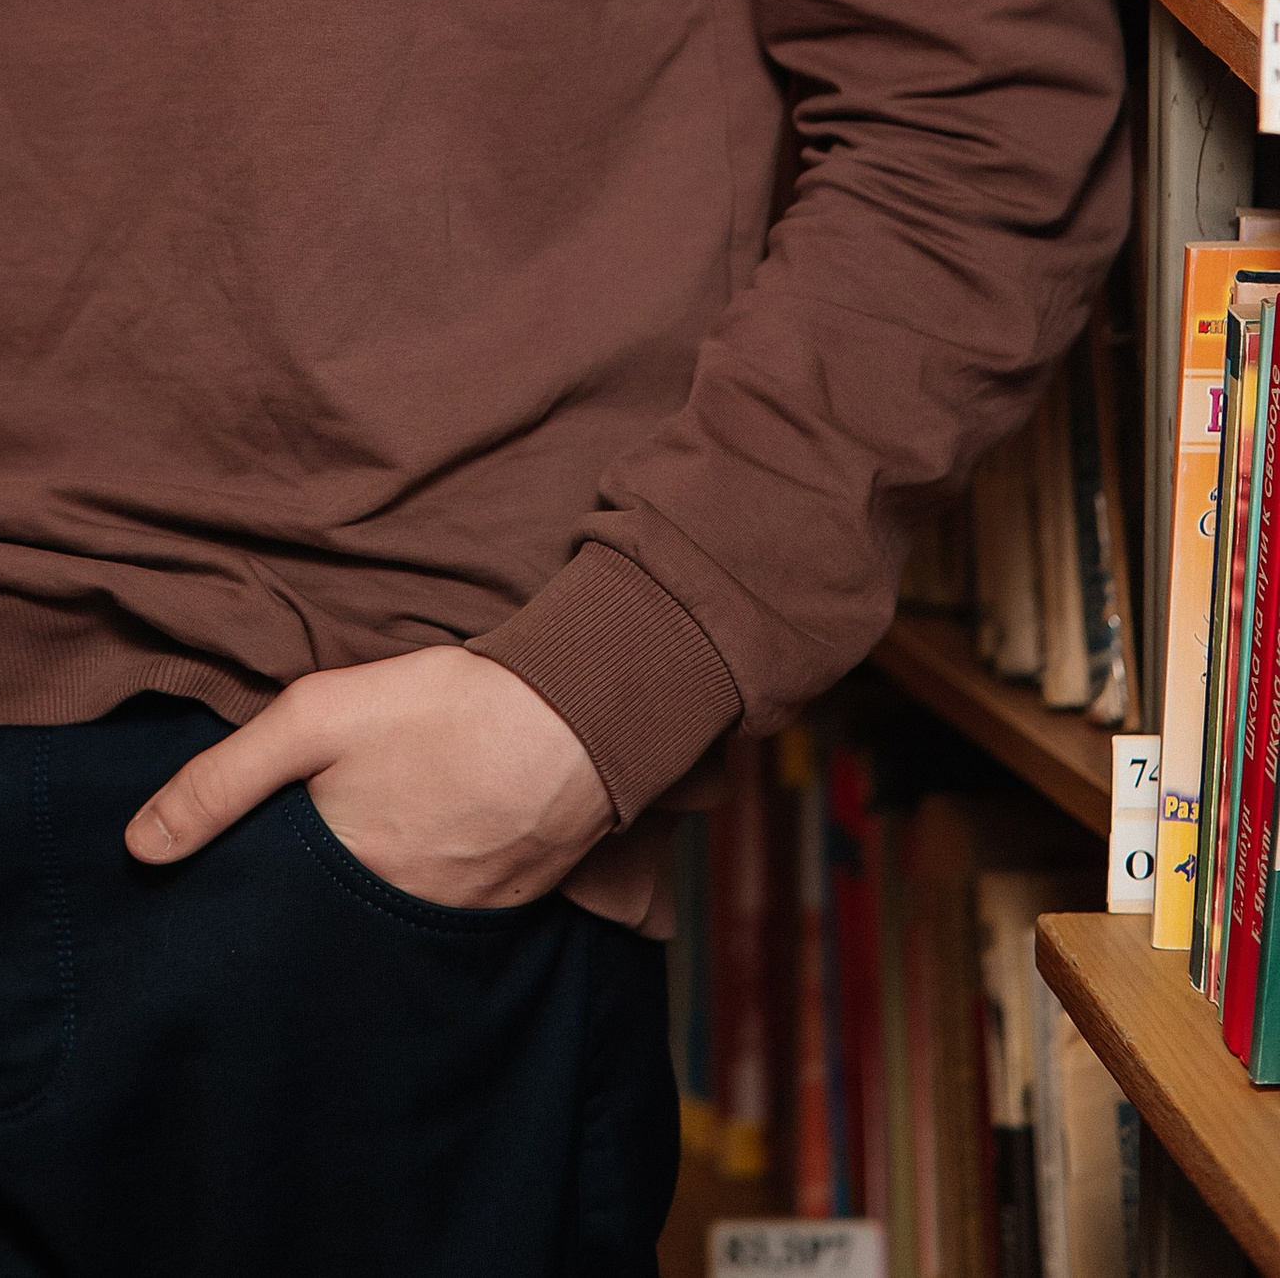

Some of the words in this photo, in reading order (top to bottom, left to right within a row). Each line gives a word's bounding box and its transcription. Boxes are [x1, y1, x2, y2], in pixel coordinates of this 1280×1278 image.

[1264, 364, 1280, 498] свободе
[1262, 503, 1271, 526] к
[1257, 530, 1269, 601] пути
[1254, 606, 1263, 648] на
[1244, 653, 1260, 760] Школа
[1164, 795, 1199, 820] Раз
[1235, 798, 1252, 899] Ямбург
